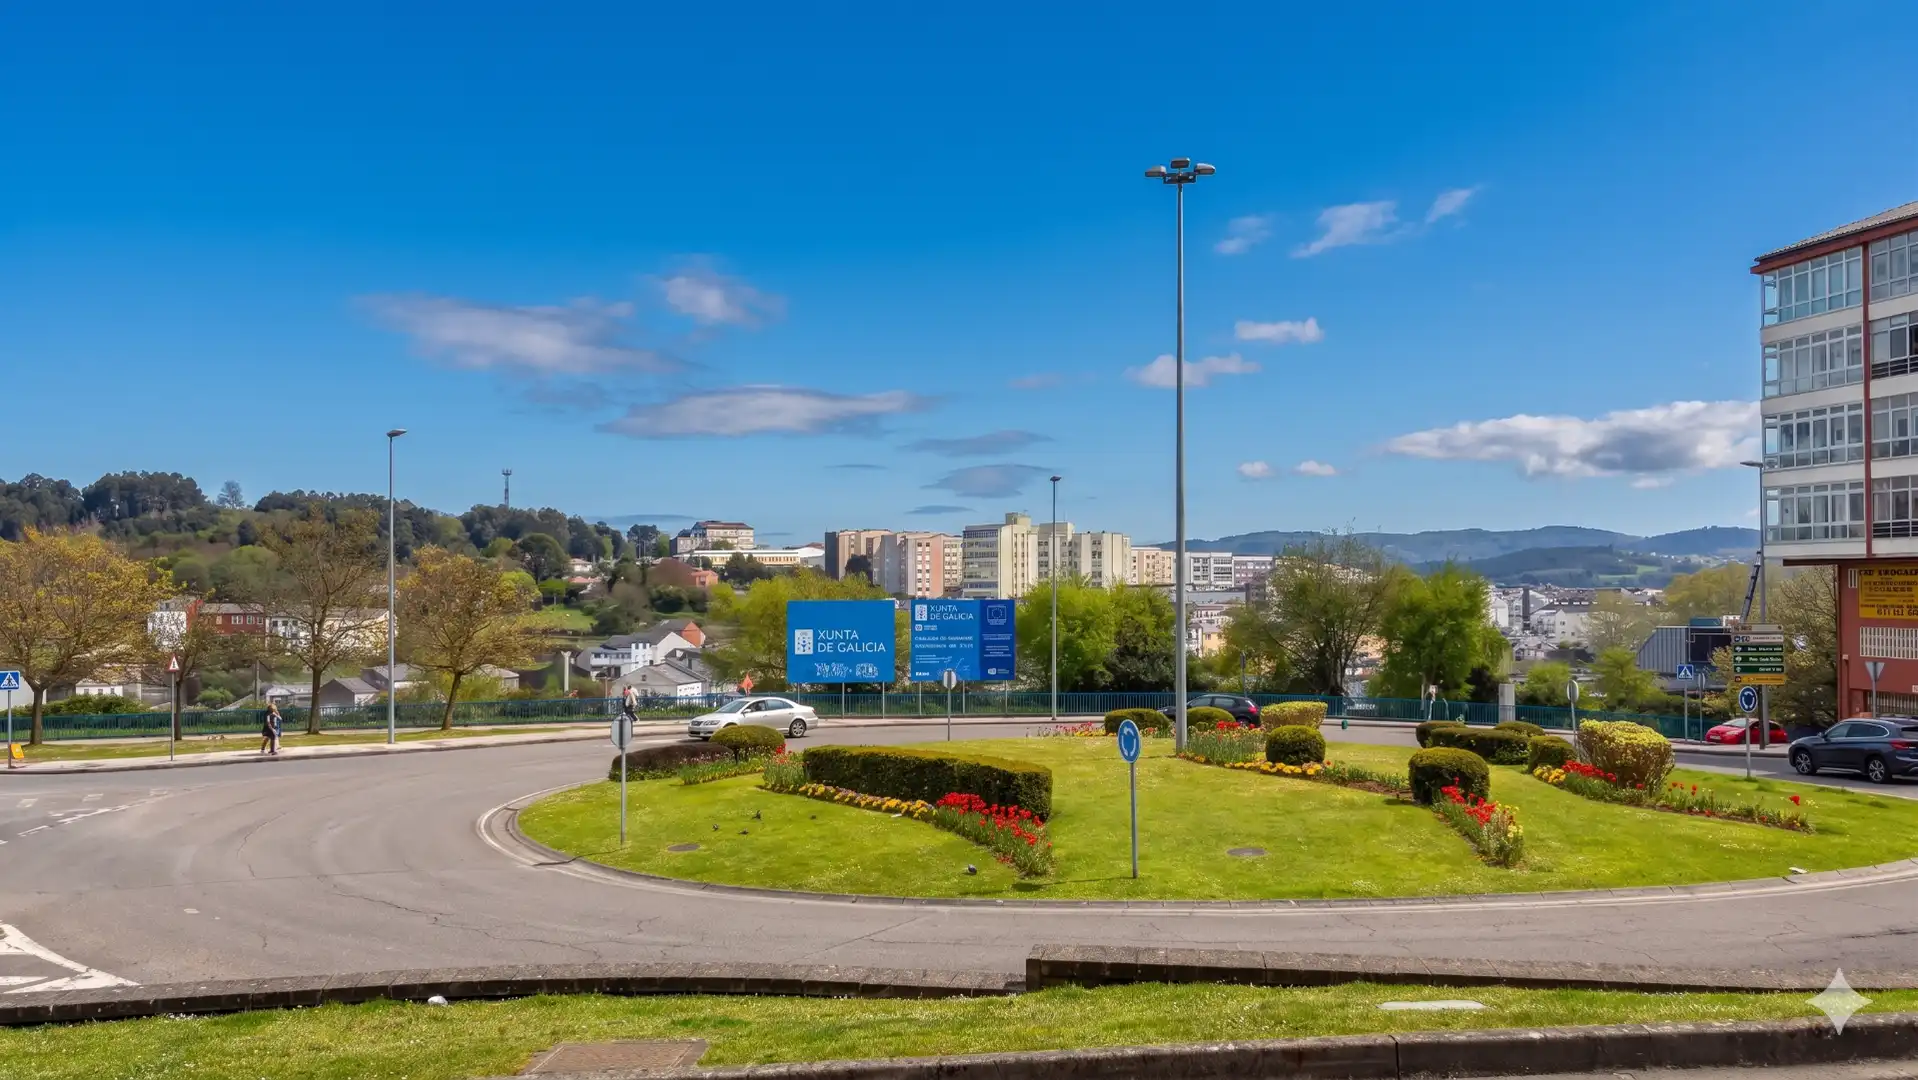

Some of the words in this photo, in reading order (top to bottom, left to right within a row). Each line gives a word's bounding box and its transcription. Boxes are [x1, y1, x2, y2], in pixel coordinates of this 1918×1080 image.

[930, 604, 958, 612] XUNTA
[817, 629, 859, 640] XUNTA
[817, 642, 834, 653] DE
[837, 642, 886, 653] GALICIA
